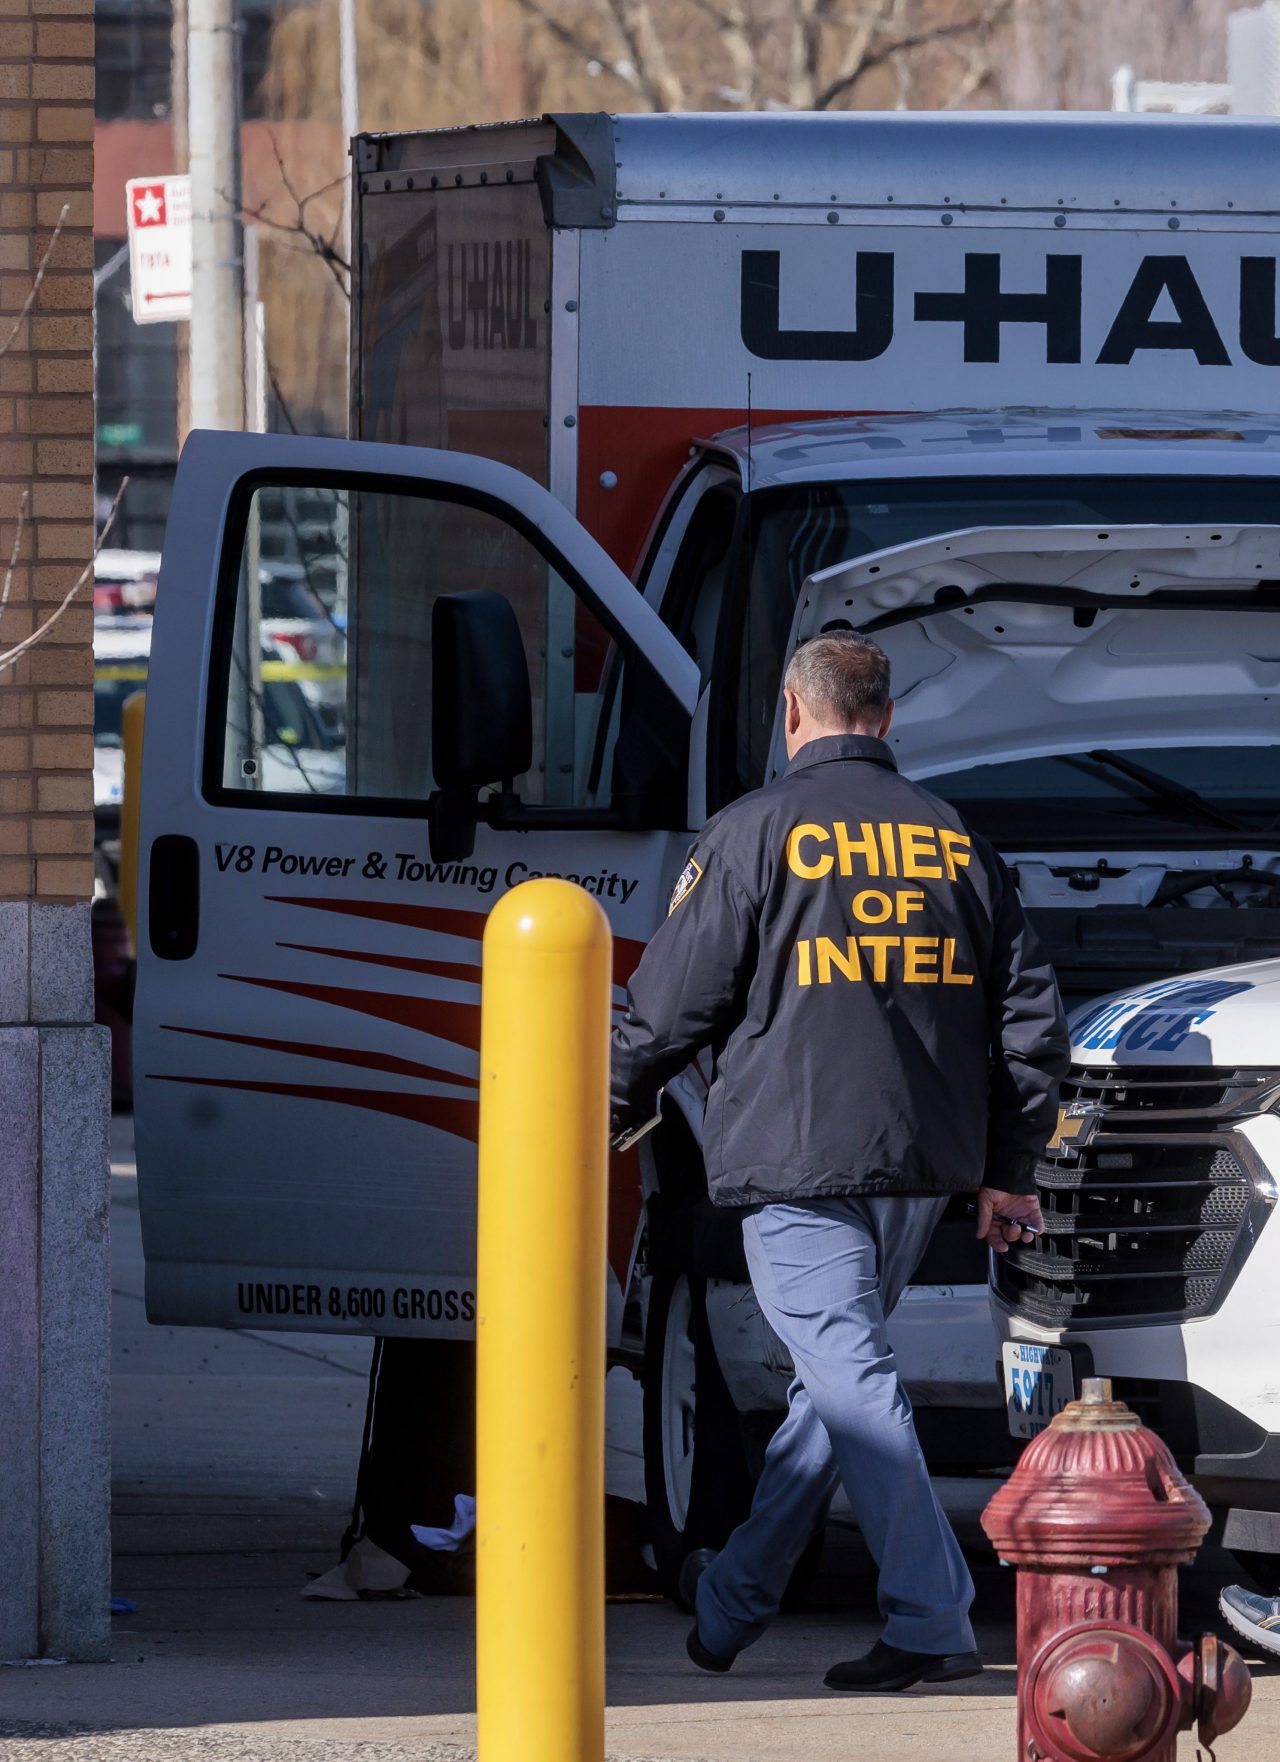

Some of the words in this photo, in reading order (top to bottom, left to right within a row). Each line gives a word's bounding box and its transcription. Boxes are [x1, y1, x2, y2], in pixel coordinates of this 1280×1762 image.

[449, 238, 538, 350] U-HAUL
[214, 844, 255, 873] V8
[262, 846, 355, 877] Power
[362, 851, 388, 880] &
[395, 853, 498, 893] Towing
[785, 821, 972, 882] CHIEF
[851, 889, 925, 924] OF
[796, 935, 974, 986] INTEL
[237, 1282, 321, 1316] UNDER
[328, 1286, 386, 1321] 8,600
[393, 1287, 475, 1322] GROSS
[1020, 1345, 1055, 1366] HIGHWAY
[1011, 1367, 1055, 1417] 5977
